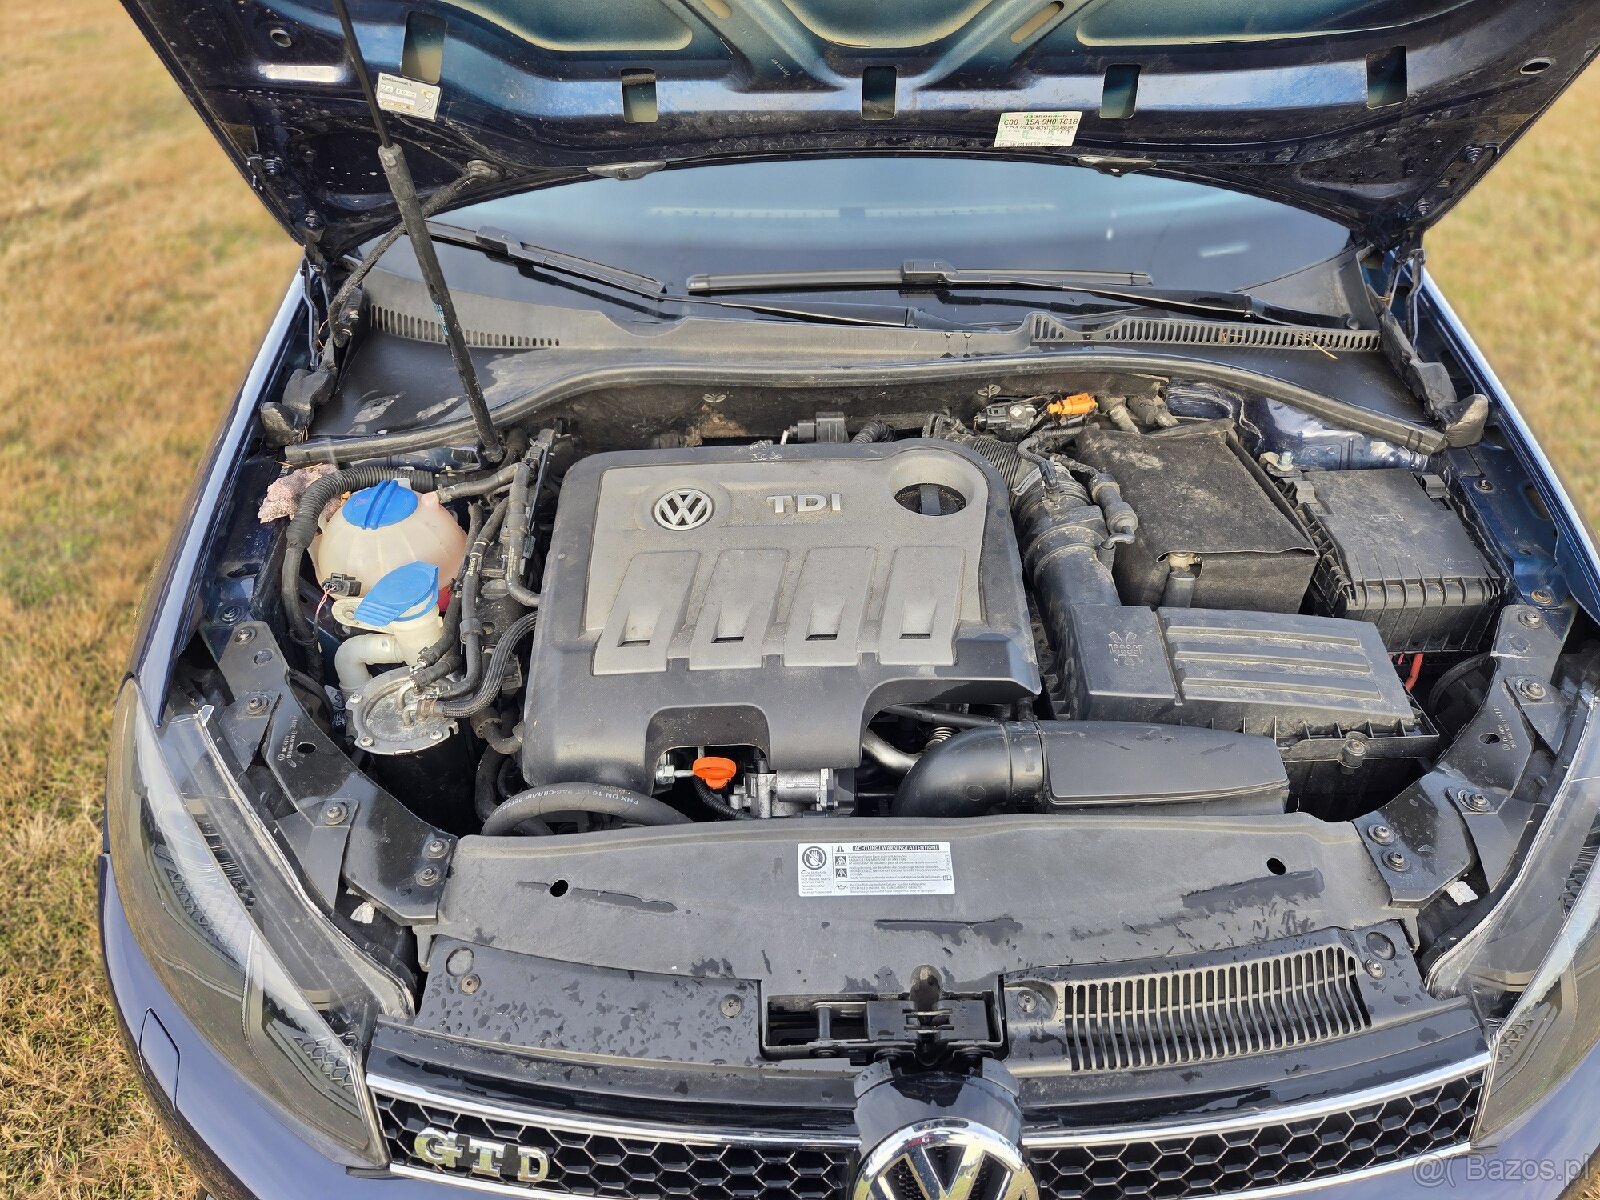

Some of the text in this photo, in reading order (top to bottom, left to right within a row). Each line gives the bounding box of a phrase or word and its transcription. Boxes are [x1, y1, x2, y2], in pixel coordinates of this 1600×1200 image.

[652, 488, 714, 531] VW
[766, 493, 842, 513] TDI
[414, 1127, 549, 1182] GTD
